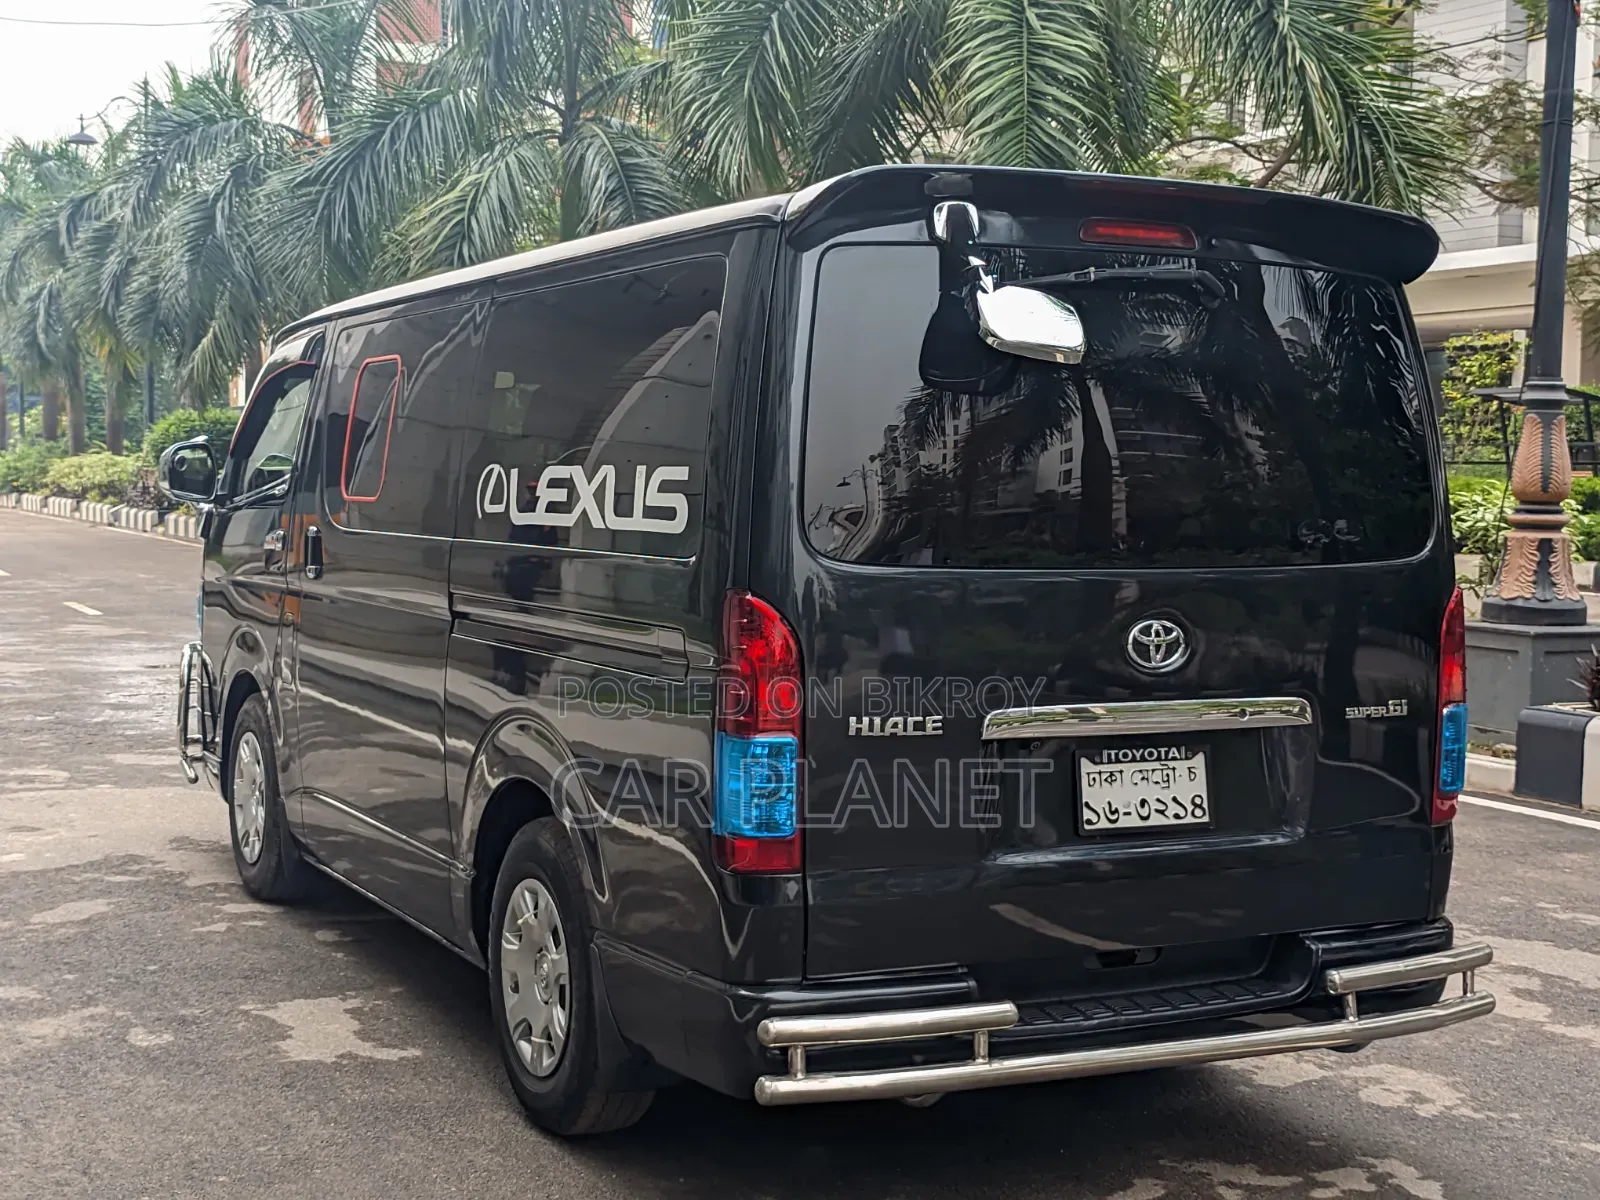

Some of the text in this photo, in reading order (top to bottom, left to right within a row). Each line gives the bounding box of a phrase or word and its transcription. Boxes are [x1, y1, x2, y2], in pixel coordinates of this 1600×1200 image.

[509, 464, 690, 534] LEXUS
[848, 715, 944, 736] HIACE
[1107, 747, 1180, 762] TOYOTA
[1086, 769, 1124, 788] ঢাকা
[1084, 794, 1207, 826] ১৬-৩২১৪
